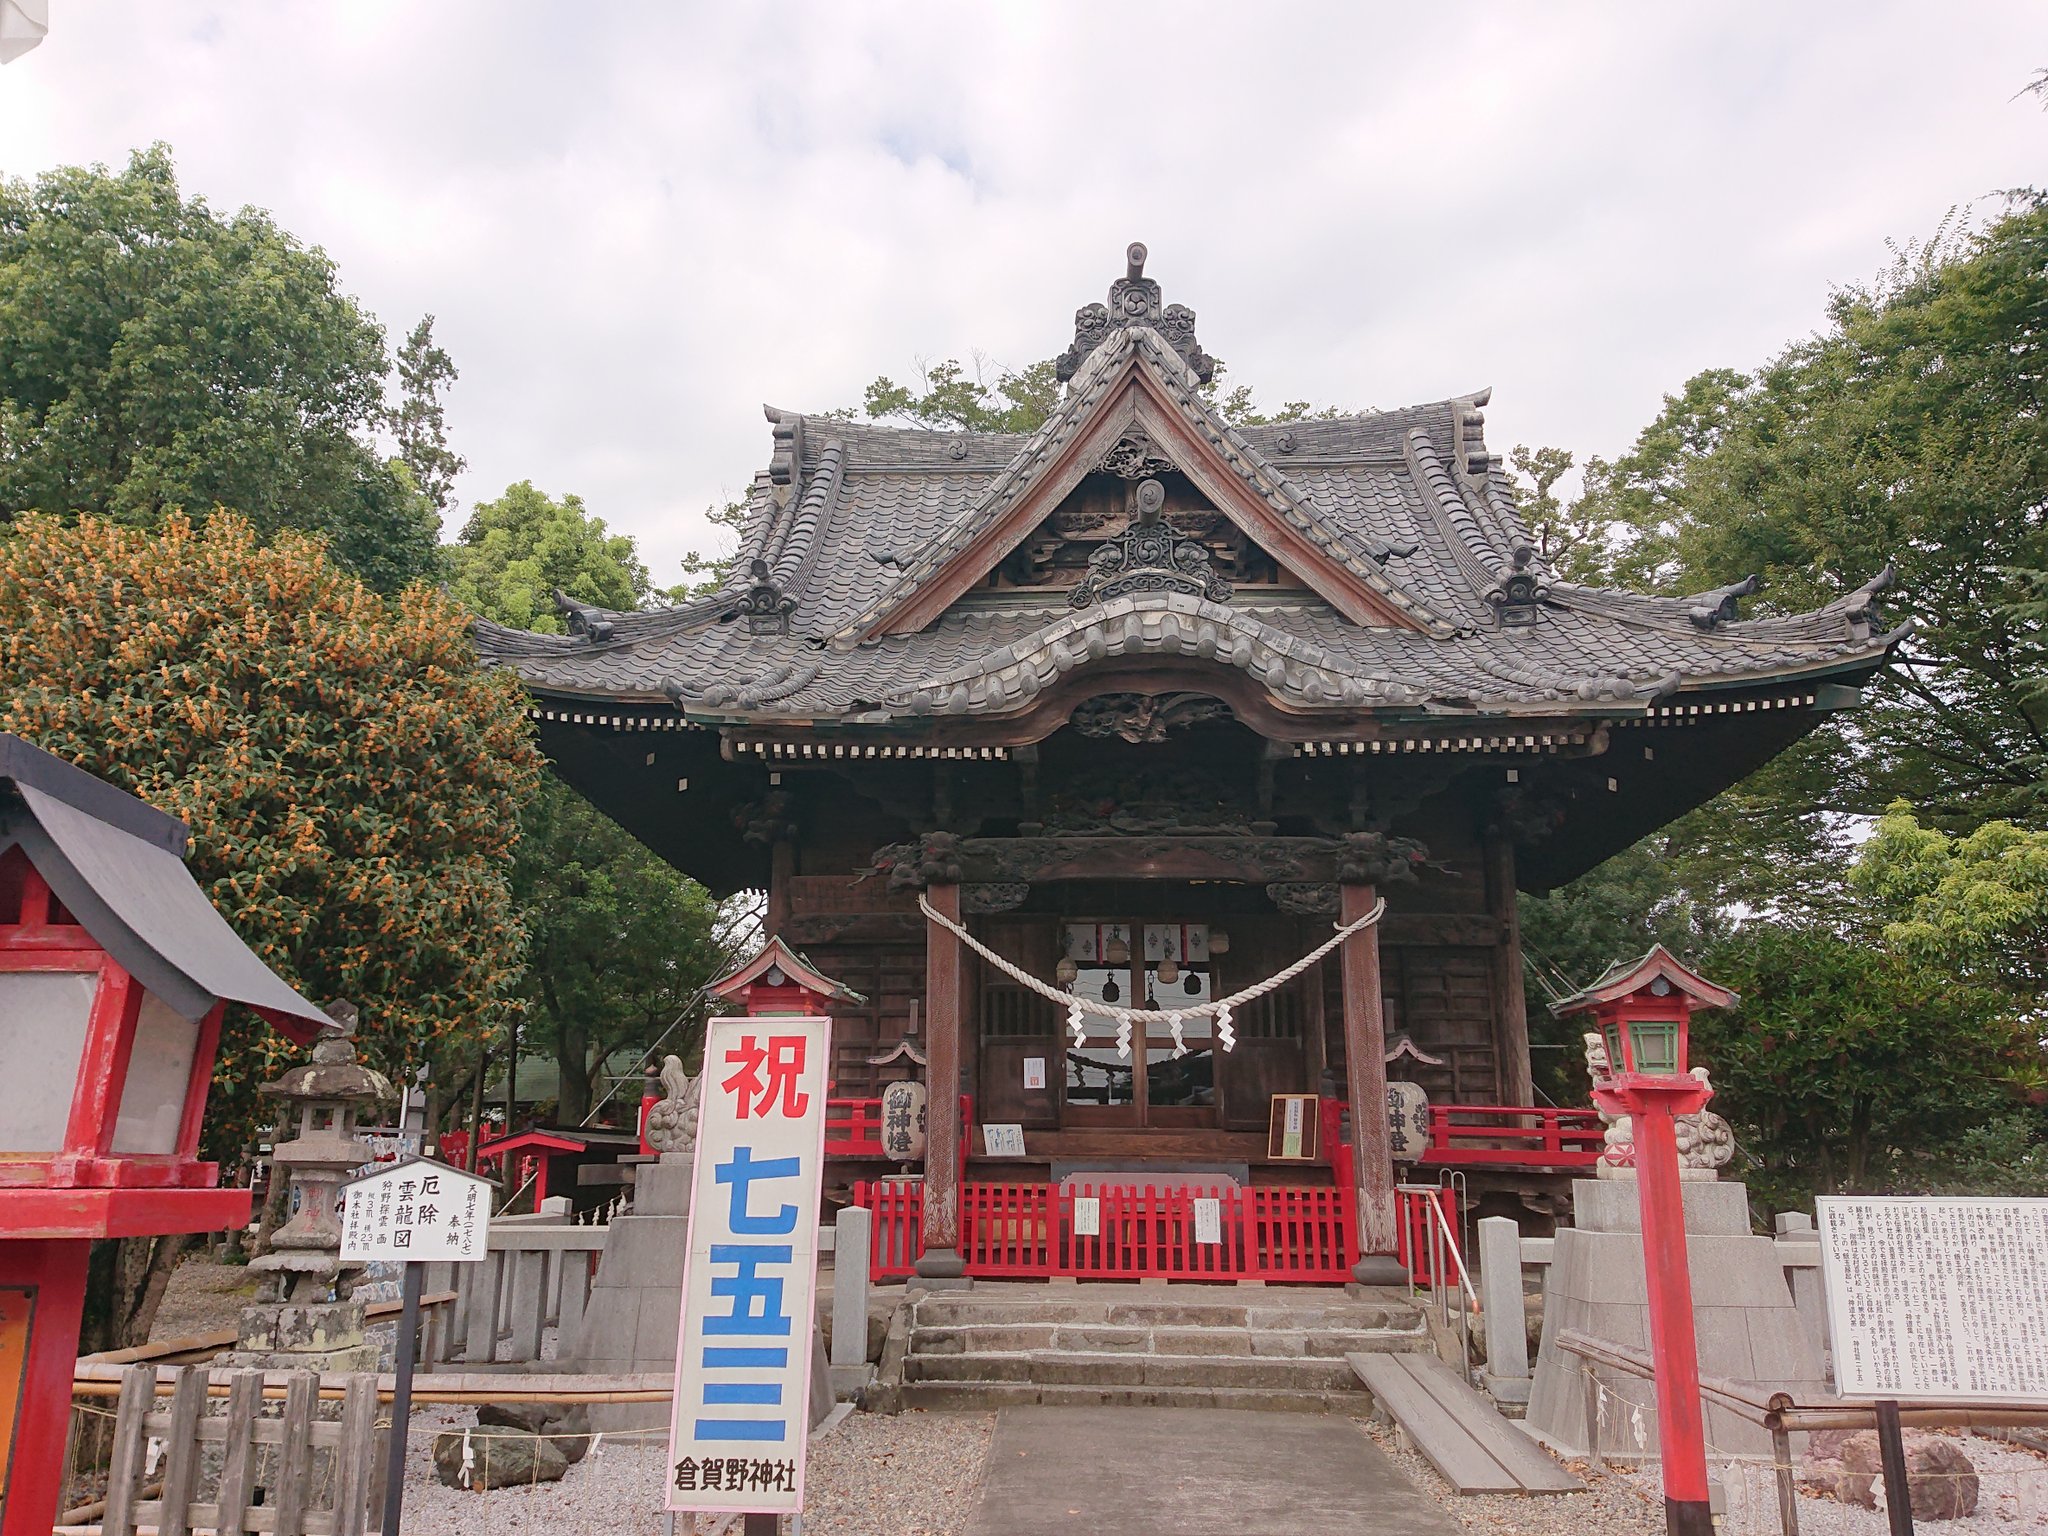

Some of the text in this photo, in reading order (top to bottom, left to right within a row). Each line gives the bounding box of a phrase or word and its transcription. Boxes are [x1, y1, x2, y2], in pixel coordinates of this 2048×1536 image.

[721, 1035, 810, 1120] 祝
[887, 1088, 913, 1152] 御神燈
[393, 1181, 417, 1249] 雲龍図
[418, 1175, 440, 1225] 厄除
[446, 1214, 461, 1246] 奉納
[693, 1146, 801, 1442] 七五三
[674, 1455, 796, 1492] 倉賀野神社
